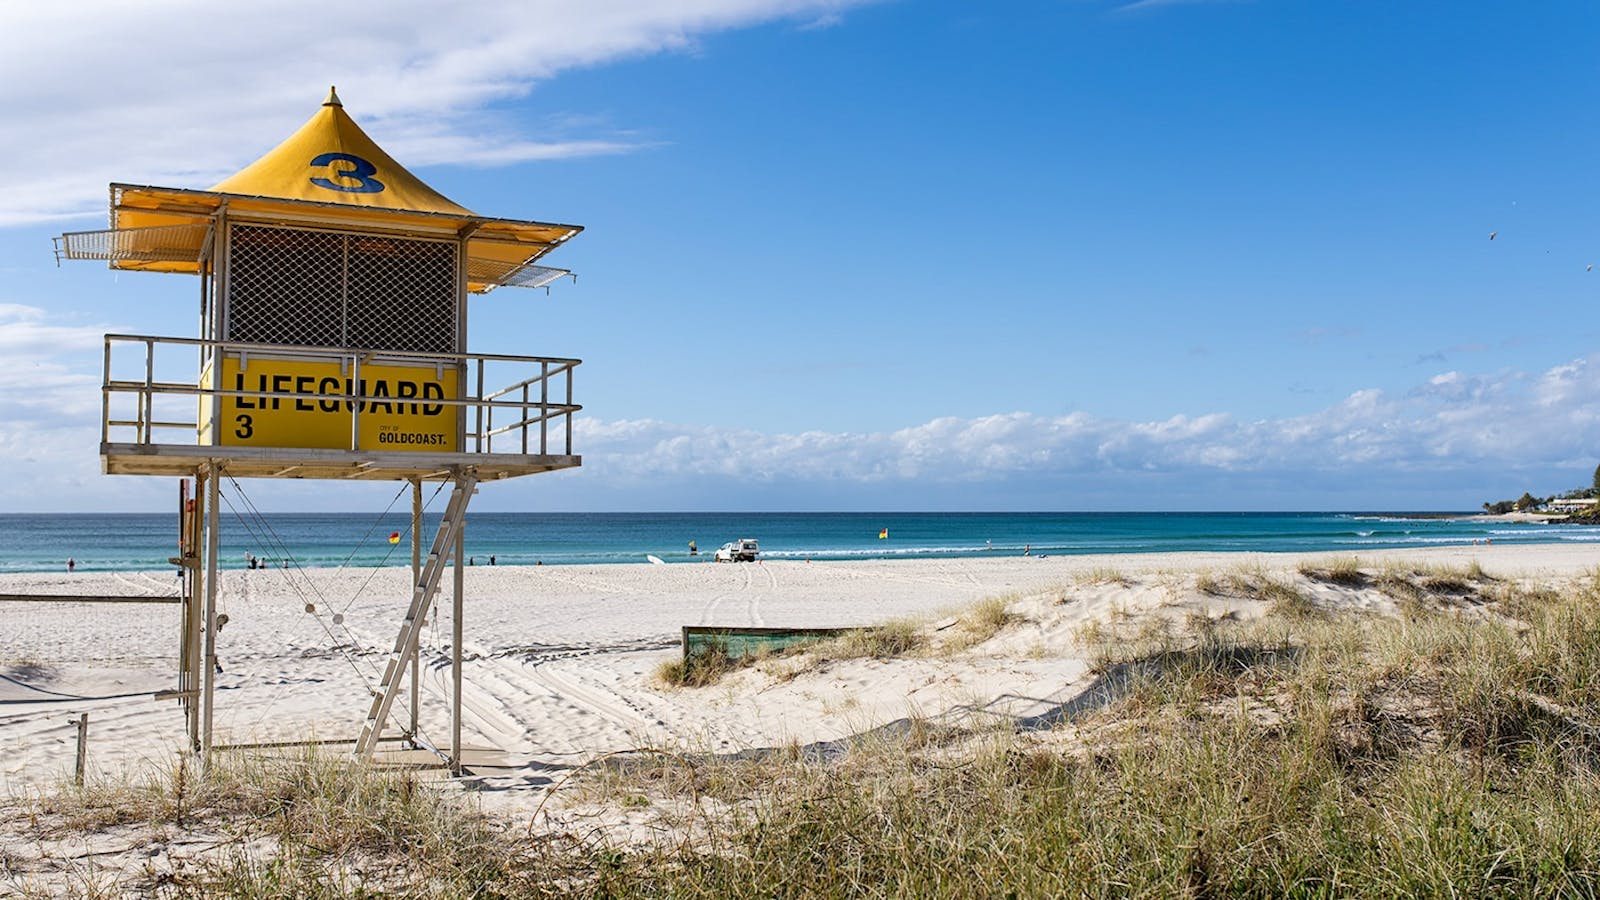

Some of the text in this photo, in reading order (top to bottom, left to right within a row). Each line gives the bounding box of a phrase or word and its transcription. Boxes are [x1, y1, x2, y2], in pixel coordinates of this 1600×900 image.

[309, 152, 385, 193] 3
[235, 373, 444, 416] LIFEGUARD
[235, 414, 253, 439] 3
[379, 432, 447, 445] GOLDCOAST.
